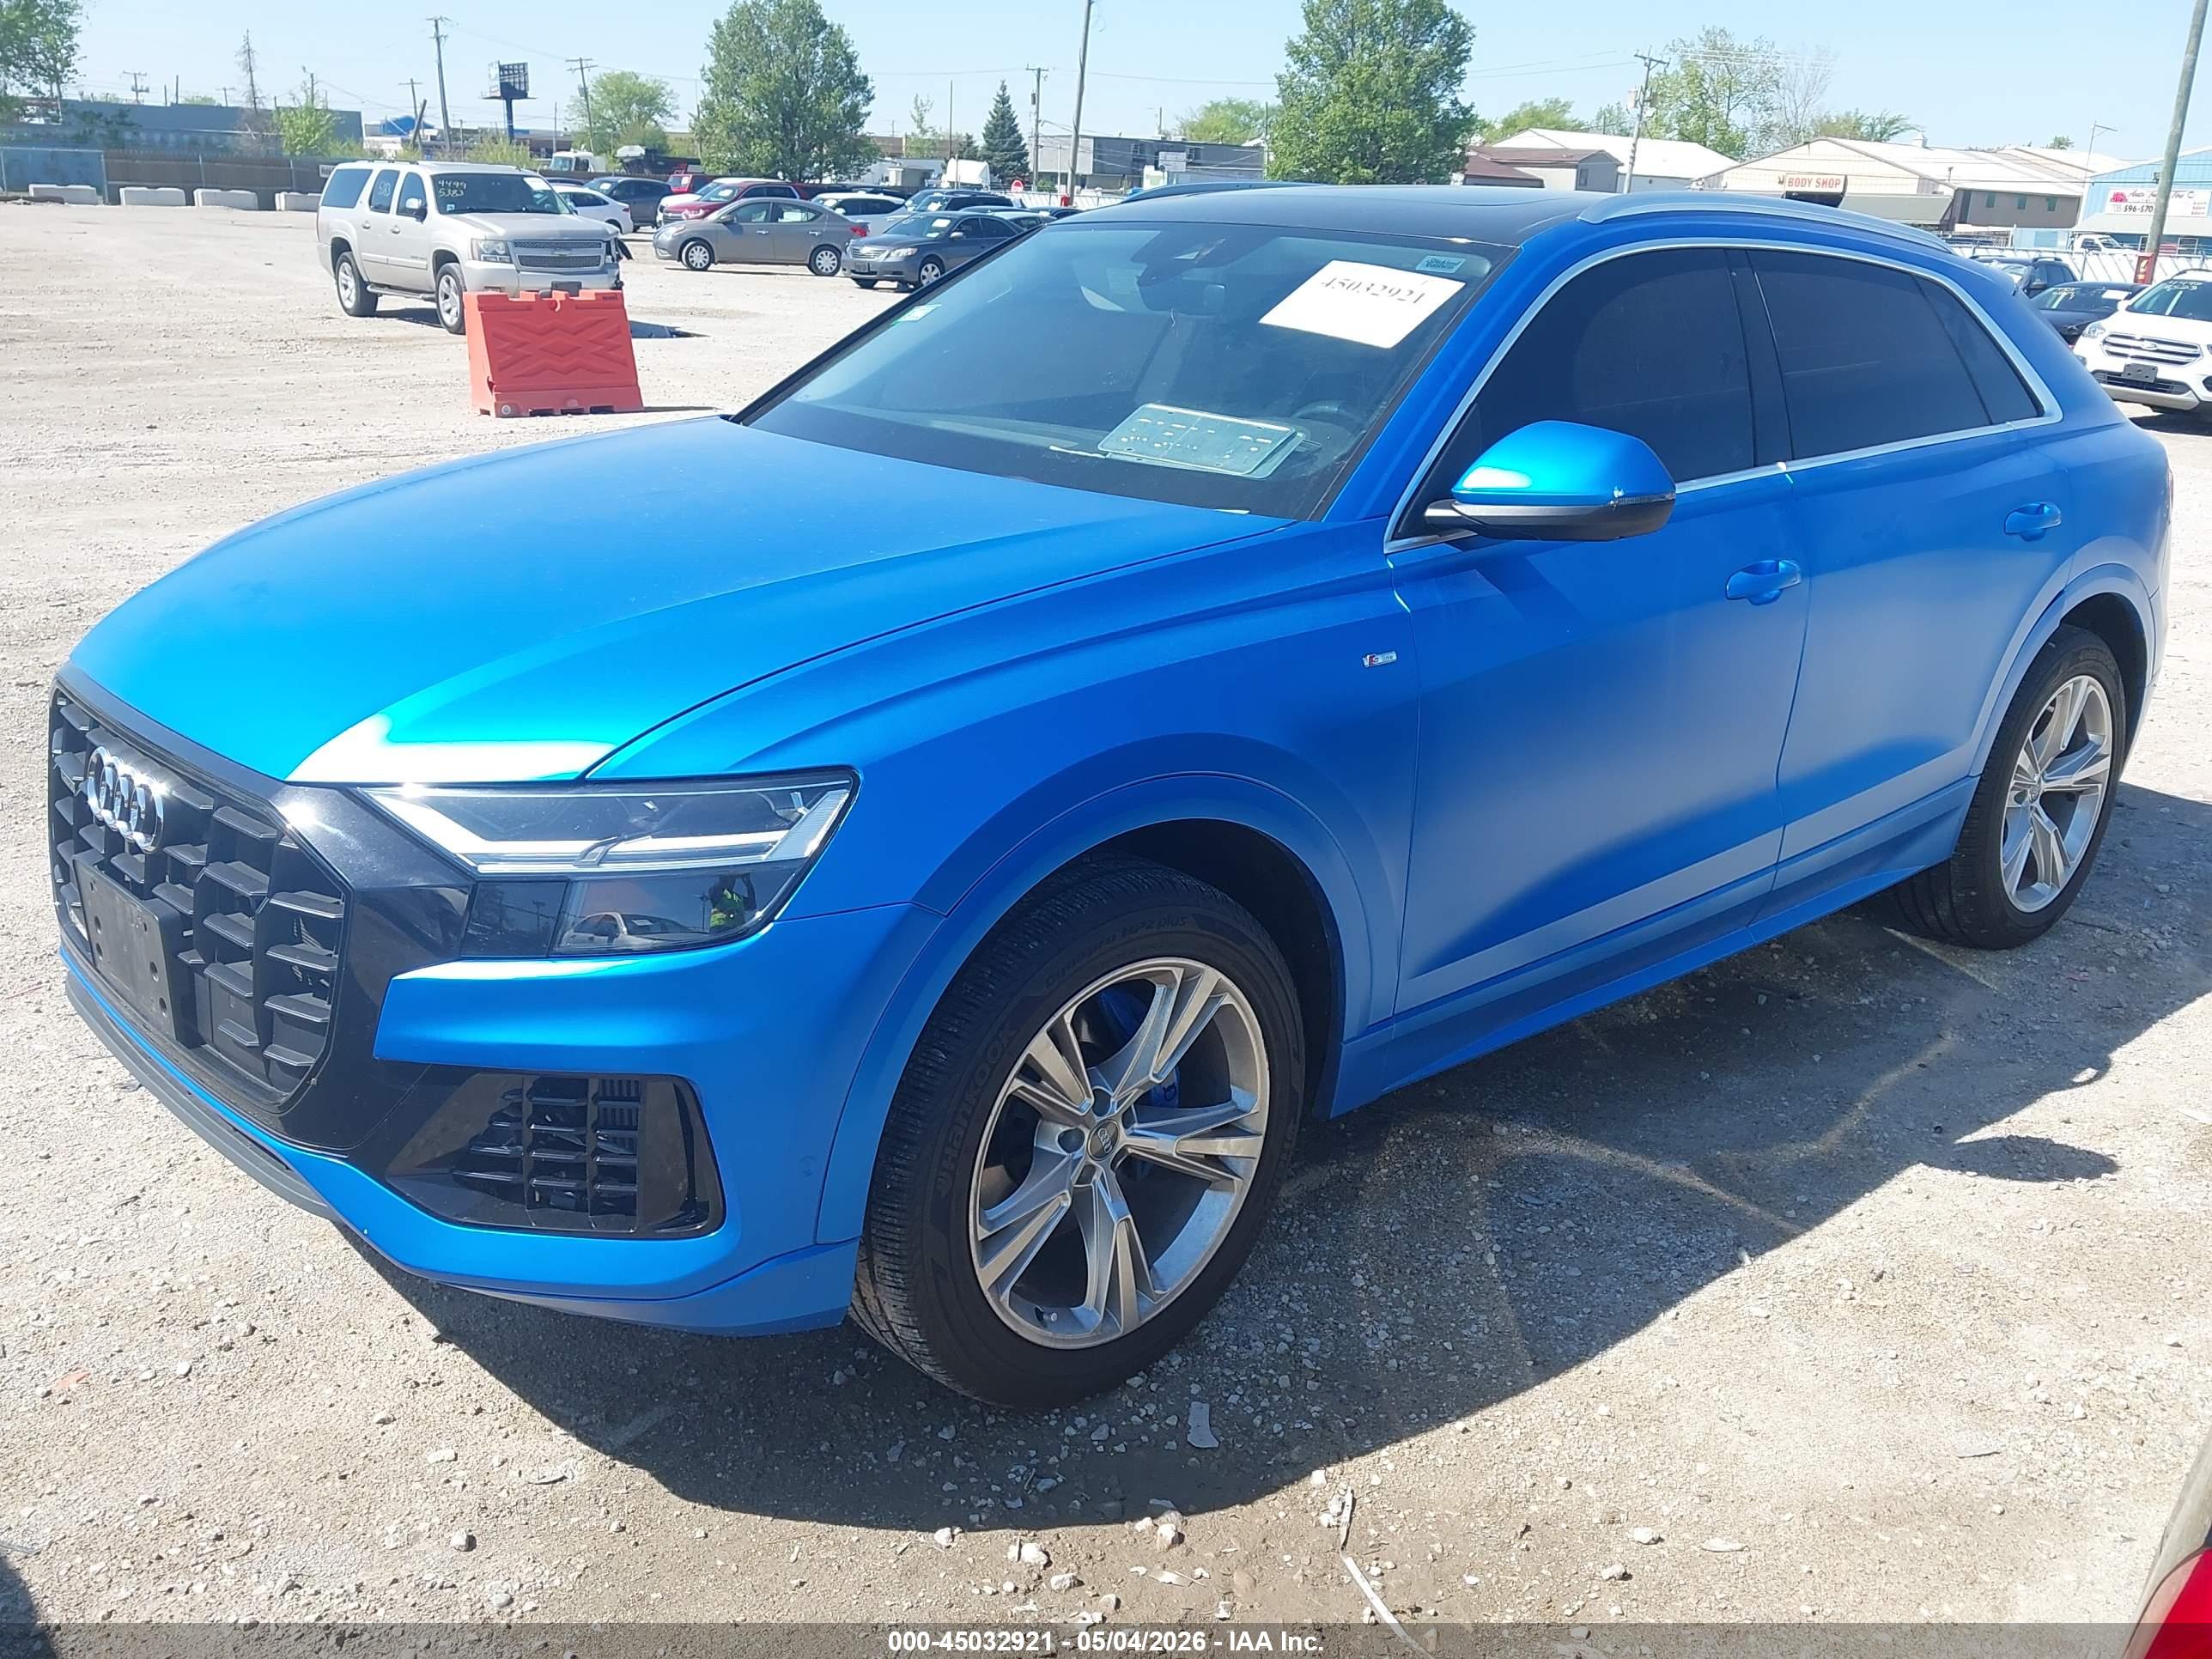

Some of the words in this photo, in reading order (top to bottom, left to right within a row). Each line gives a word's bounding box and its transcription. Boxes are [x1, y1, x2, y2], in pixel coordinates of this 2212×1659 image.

[438, 179, 466, 189] 4499
[1788, 177, 1813, 187] BODY
[1815, 178, 1841, 188] SHOP
[439, 188, 465, 198] 5383
[1321, 277, 1425, 303] 45032921
